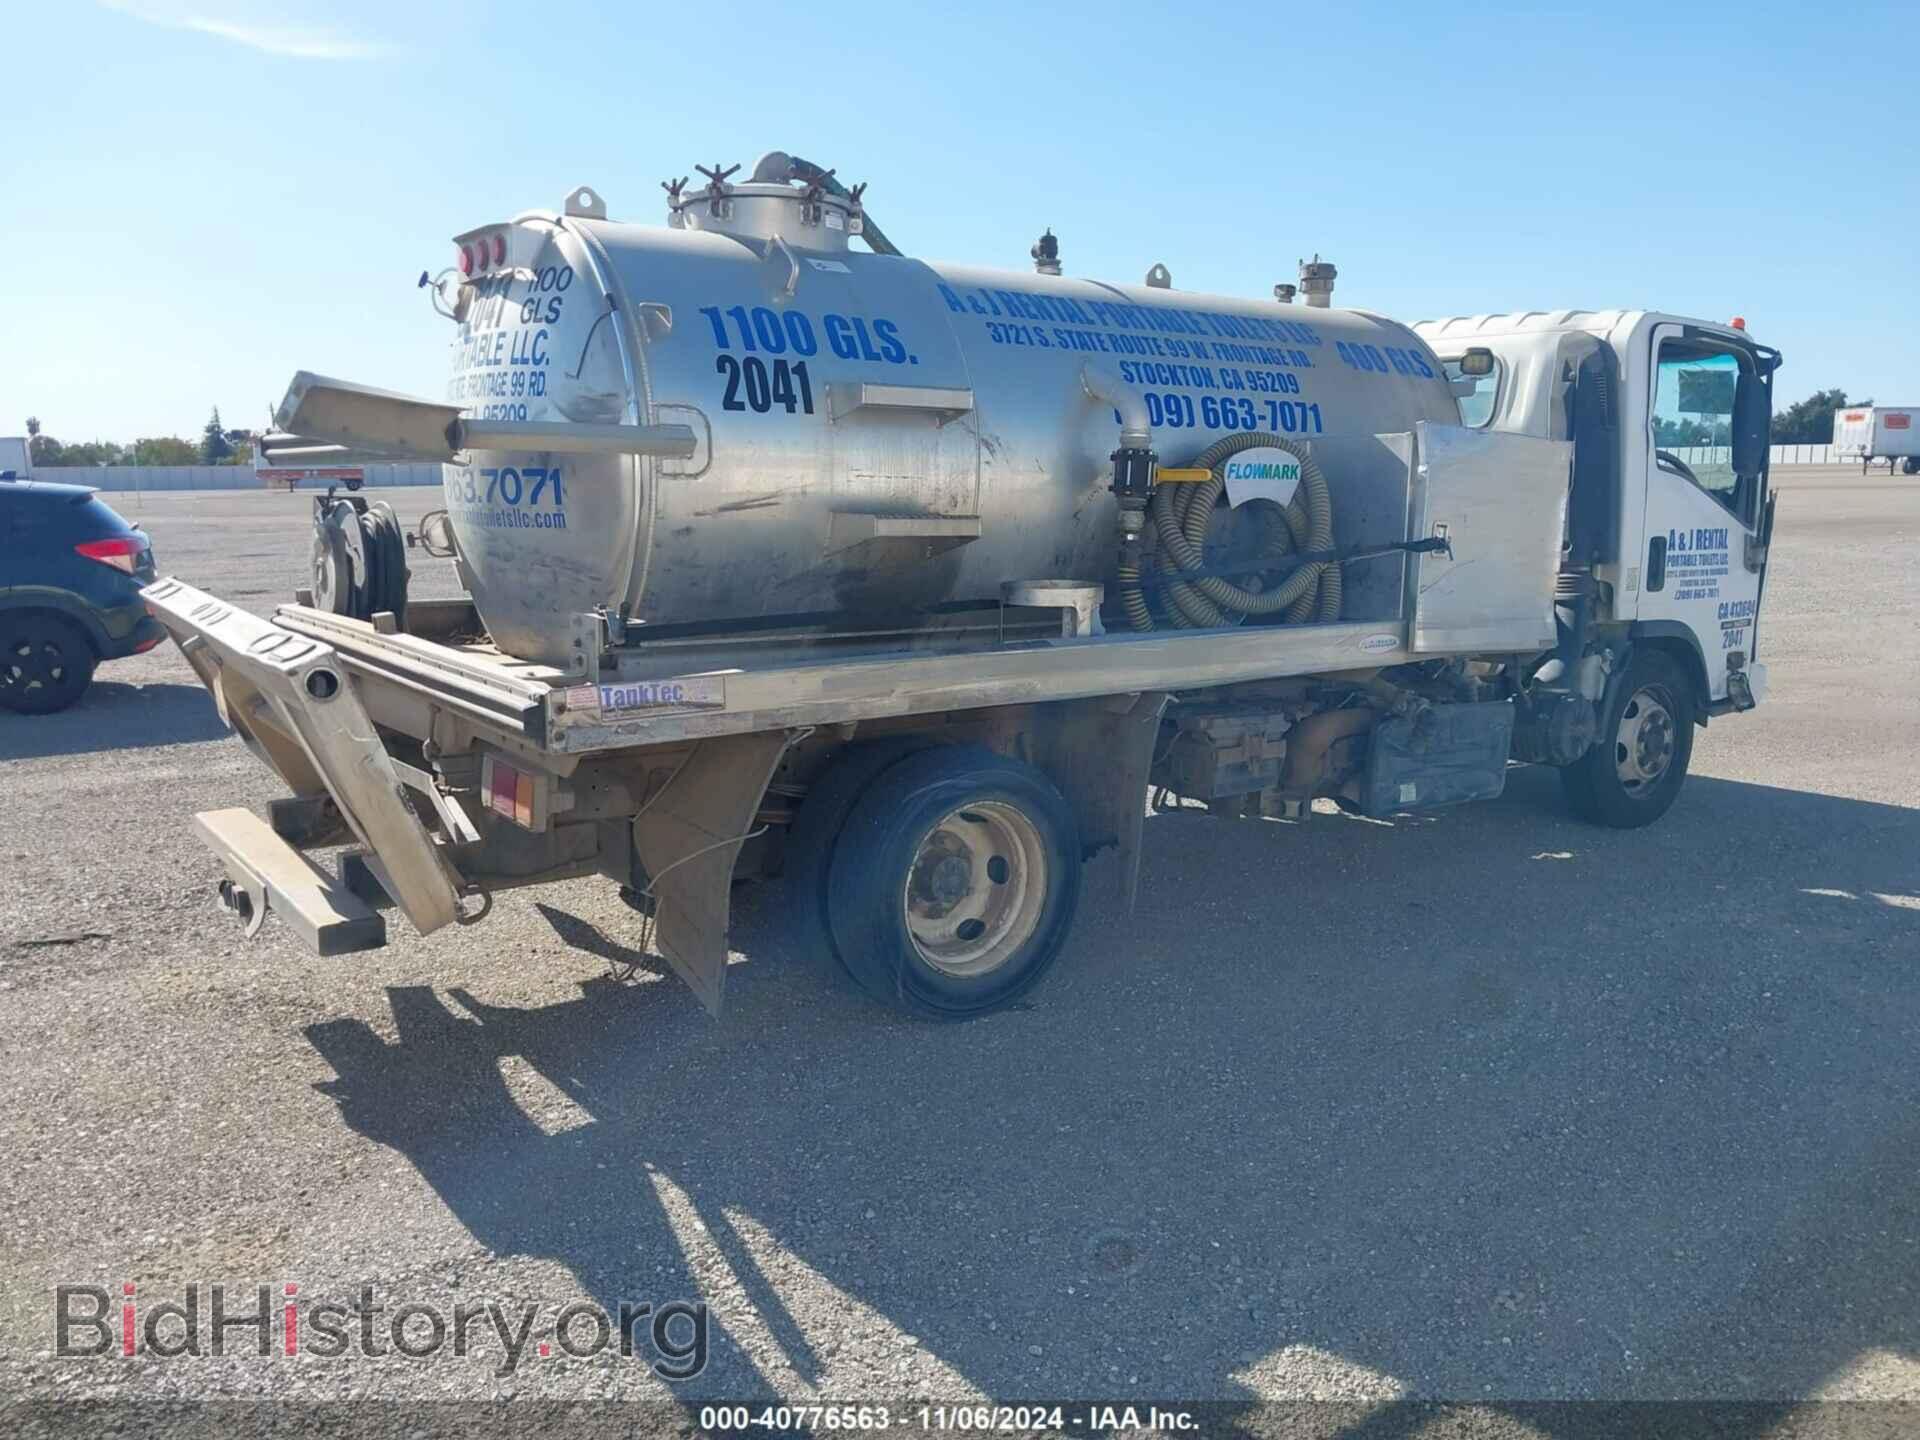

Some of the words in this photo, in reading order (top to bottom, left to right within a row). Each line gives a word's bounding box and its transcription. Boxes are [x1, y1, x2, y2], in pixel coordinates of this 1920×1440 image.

[520, 296, 563, 325] GLS
[936, 283, 968, 312] A
[966, 295, 987, 314] &
[993, 290, 1096, 325] RENTAL
[510, 329, 550, 366] LLC.
[699, 305, 818, 357] 1100
[823, 314, 919, 365] GLS.
[985, 322, 1034, 346] 3721
[1032, 326, 1055, 347] S.
[1053, 328, 1109, 352] STATE
[1105, 333, 1167, 357] ROUTE
[1164, 338, 1190, 358] 99
[1210, 342, 1290, 366] FRONTAGE
[510, 371, 525, 397] 99
[528, 370, 547, 396] RD.
[716, 354, 814, 414] 2041
[1119, 360, 1221, 391] STOCKTON,
[1219, 367, 1246, 391] CA
[1244, 369, 1300, 394] 95209
[1115, 392, 1196, 428] 09)
[1200, 395, 1323, 433] 663-7071
[1227, 463, 1299, 480] FLOWMARK
[1668, 529, 1676, 551] A
[1679, 532, 1686, 551] &
[1688, 529, 1694, 550] J
[1696, 528, 1728, 549] RENTAL
[602, 684, 684, 708] TankTec
